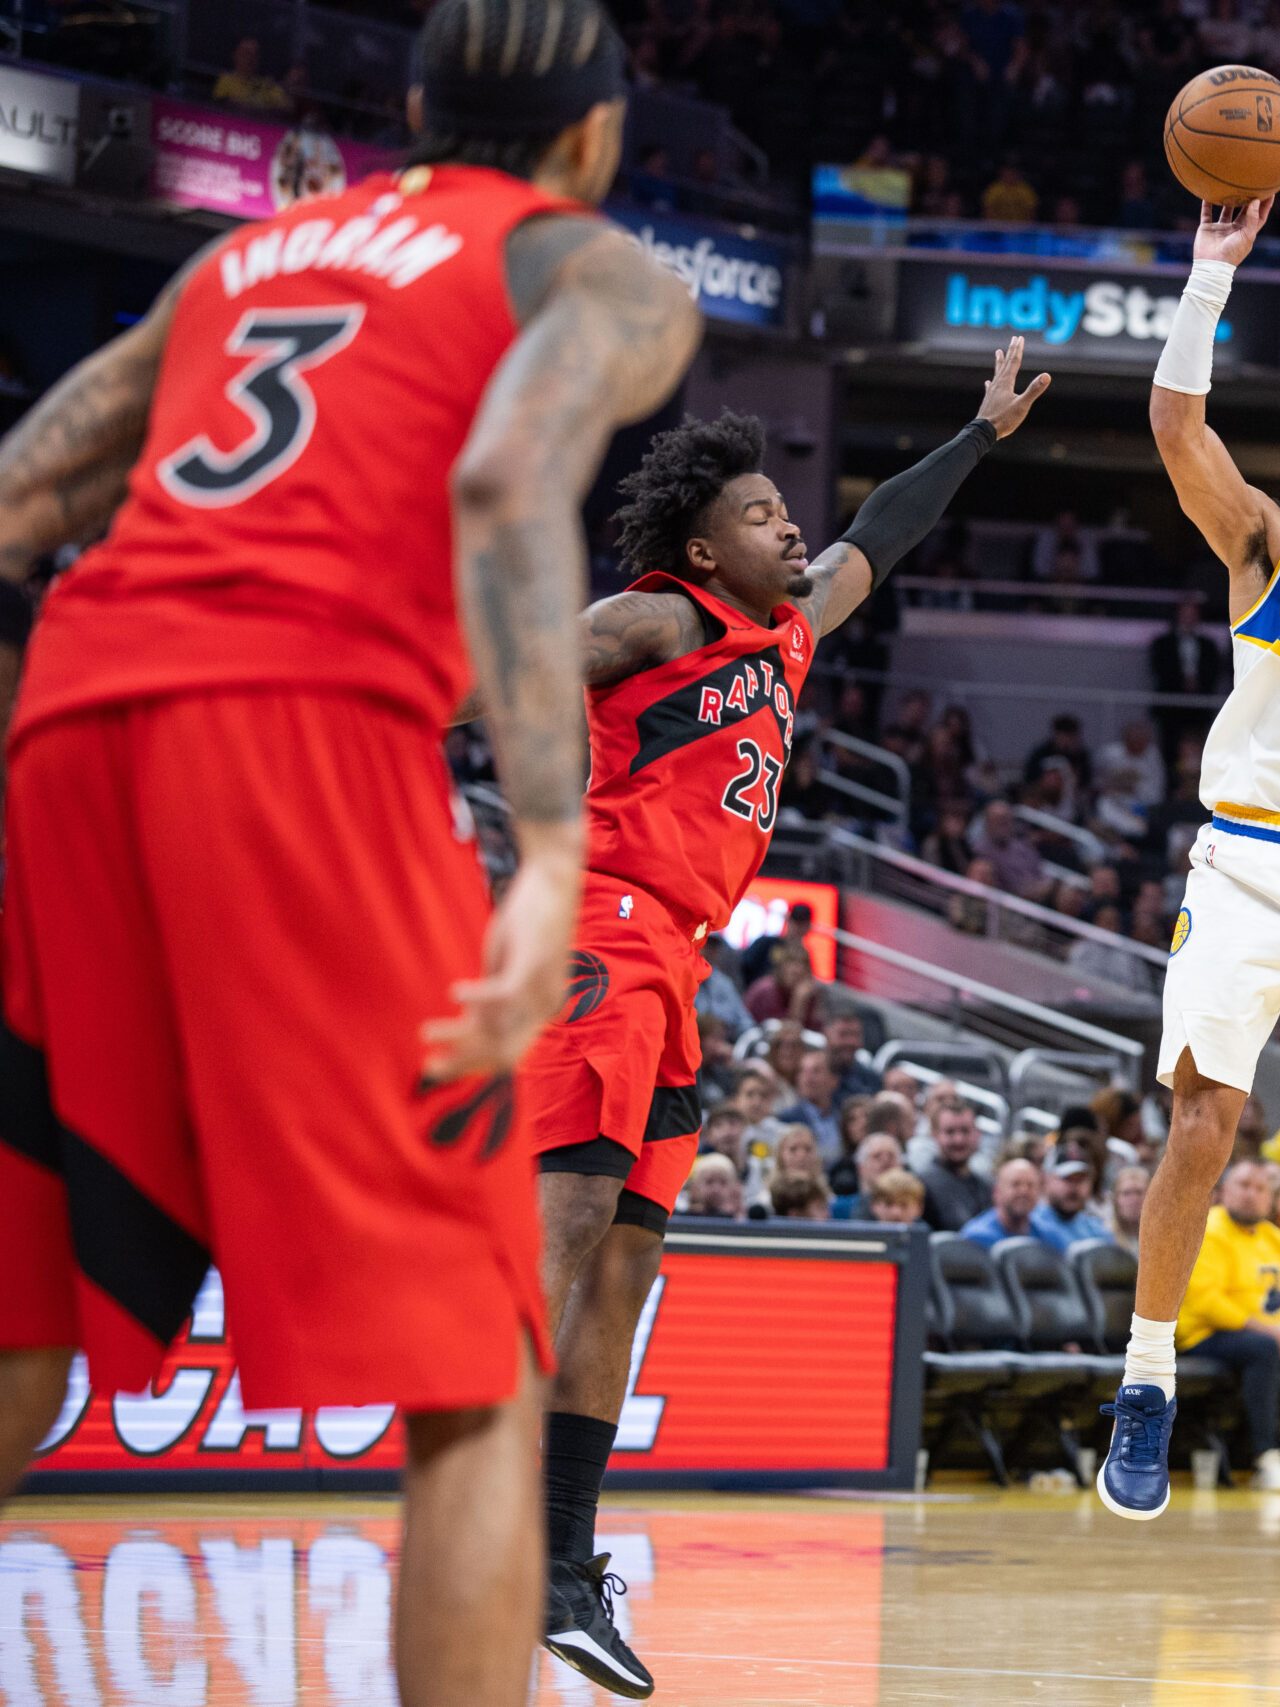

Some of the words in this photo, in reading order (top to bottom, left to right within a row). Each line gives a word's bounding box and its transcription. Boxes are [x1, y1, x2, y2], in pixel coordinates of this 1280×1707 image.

[220, 215, 464, 298] INGRAM
[946, 272, 1234, 346] IndySta.
[156, 302, 367, 509] 3
[698, 659, 793, 752] RAPTOR
[720, 738, 784, 833] 23
